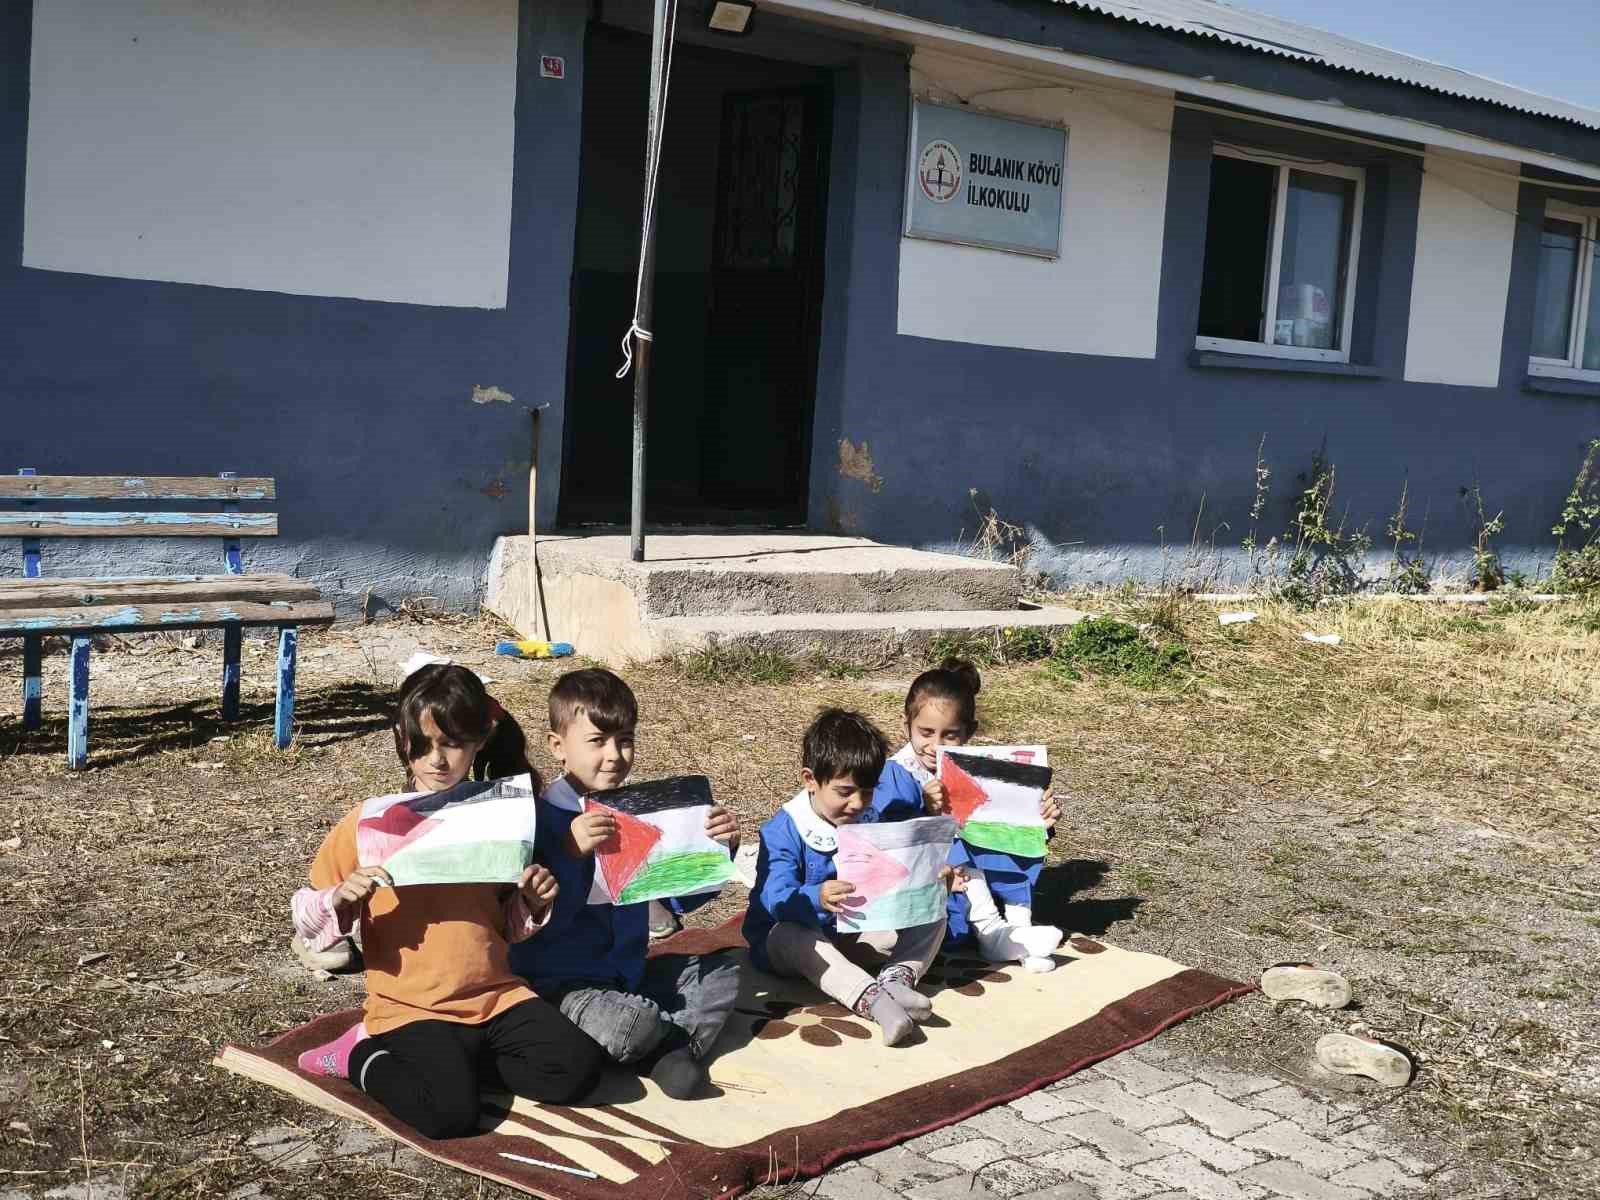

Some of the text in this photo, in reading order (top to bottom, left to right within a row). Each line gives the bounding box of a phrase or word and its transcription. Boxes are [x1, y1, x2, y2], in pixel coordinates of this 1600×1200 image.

[969, 153, 1025, 181] BULANIK
[1027, 160, 1061, 187] KÖYÜ
[967, 180, 1031, 213] İLKOKULU
